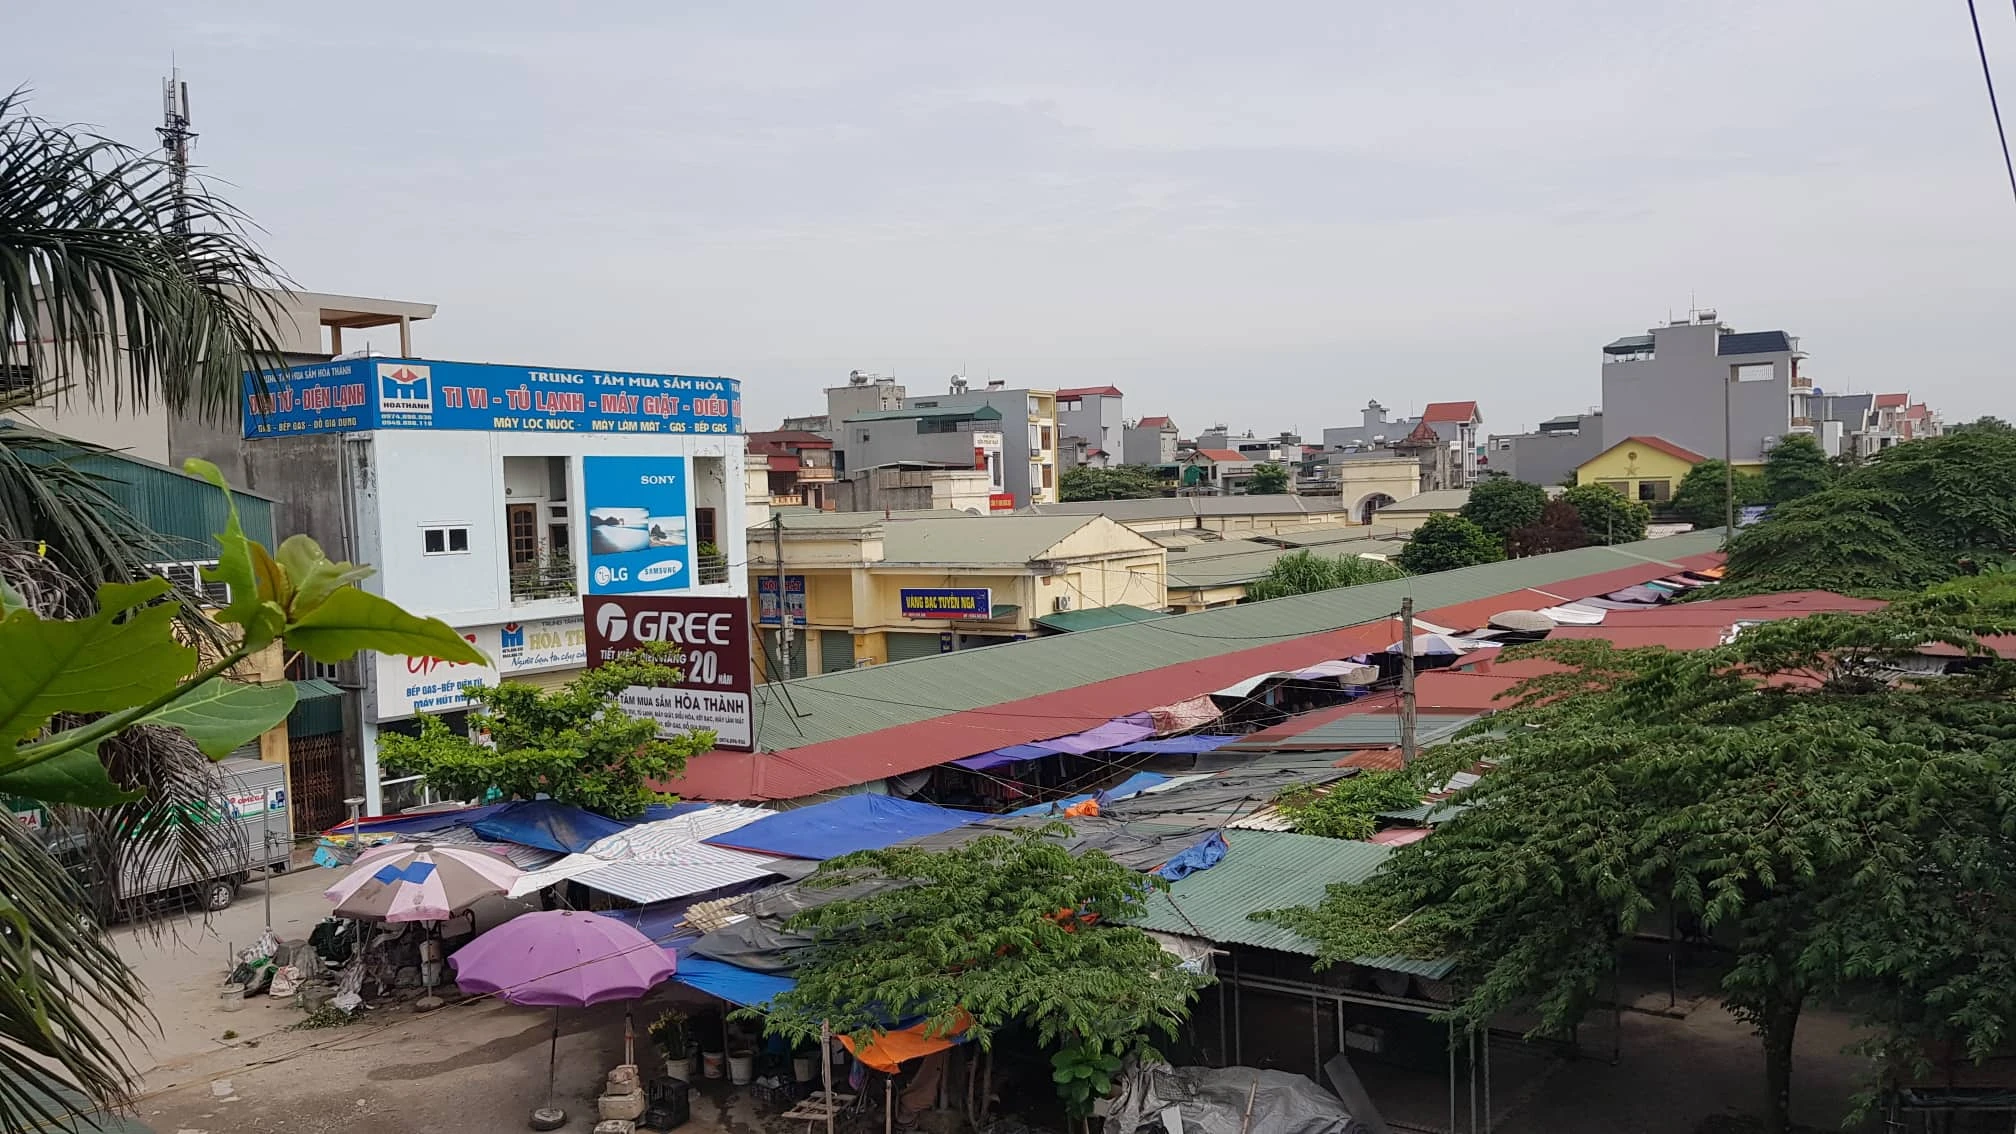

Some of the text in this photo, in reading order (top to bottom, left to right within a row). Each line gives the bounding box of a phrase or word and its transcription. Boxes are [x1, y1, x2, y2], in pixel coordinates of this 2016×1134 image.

[528, 371, 725, 392] TRUNG TÂM MUA SẮM HÒA
[302, 383, 331, 414] ĐIỆN
[333, 383, 366, 412] LẠNH
[442, 386, 463, 408] TI
[466, 387, 488, 409] VI
[505, 384, 531, 410] TỦ
[535, 391, 585, 415] LẠNH
[601, 390, 639, 414] MÁY
[643, 393, 679, 419] GIẶT
[292, 421, 306, 431] GAS
[324, 418, 336, 427] GIA
[493, 416, 519, 429] MÁY
[592, 420, 615, 431] MÁY
[669, 422, 686, 432] GAS
[694, 420, 709, 432] BẾP
[711, 423, 728, 433] GAS
[640, 475, 676, 485] SONY
[611, 567, 628, 582] LG
[644, 566, 677, 576] SAMSUNG
[961, 596, 975, 608] NGA
[633, 611, 732, 645] GREE
[529, 627, 562, 650] HÒA
[600, 646, 616, 660] TIẾT
[689, 650, 717, 684] 20
[406, 684, 421, 697] BẾP
[436, 695, 454, 706] HÚT
[620, 693, 635, 704] TÂM
[637, 696, 653, 706] MUA
[655, 694, 671, 708] SẮM
[674, 693, 700, 710] HÒA
[703, 694, 744, 713] THÀNH
